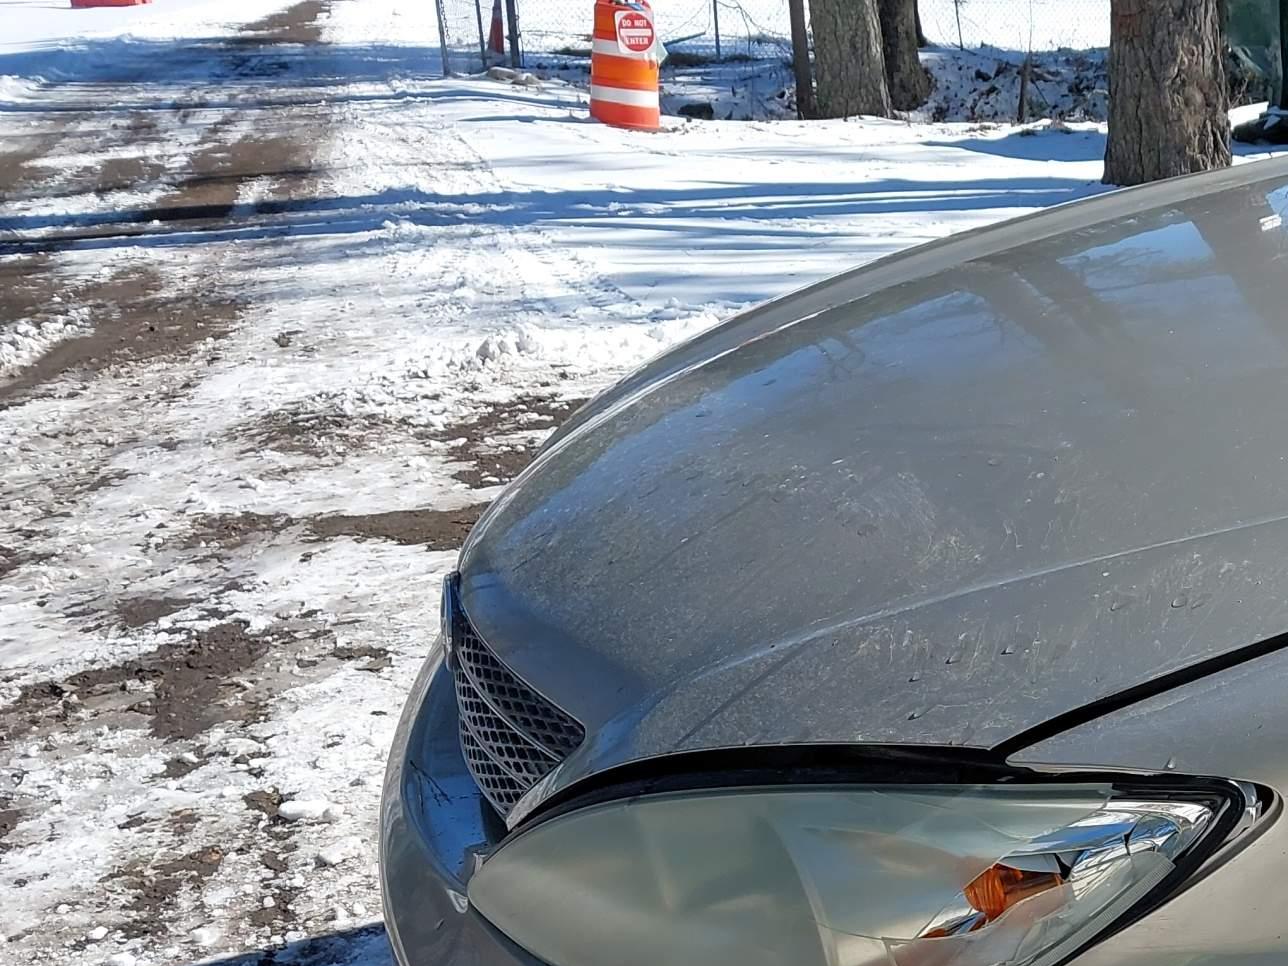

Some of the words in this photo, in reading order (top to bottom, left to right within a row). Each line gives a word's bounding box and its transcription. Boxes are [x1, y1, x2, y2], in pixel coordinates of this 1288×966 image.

[621, 19, 632, 27] DO
[634, 19, 647, 27] NOT
[625, 37, 649, 45] ENTER
